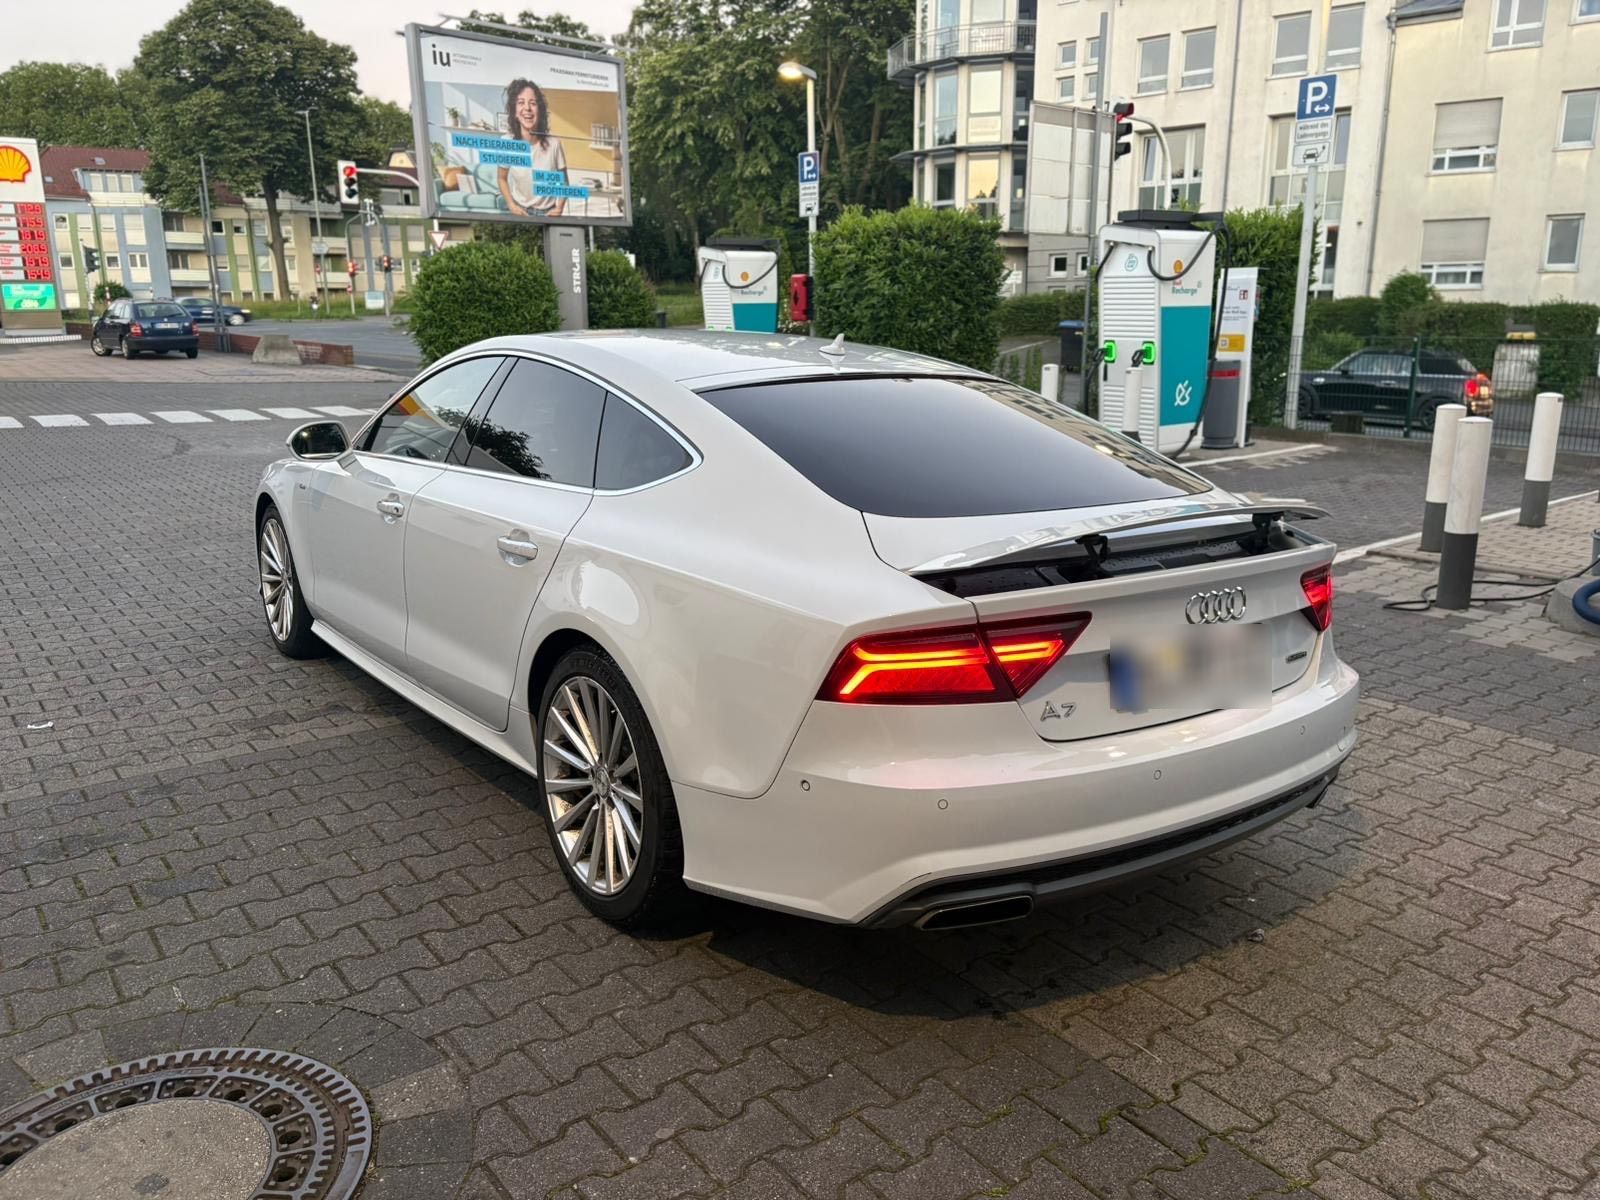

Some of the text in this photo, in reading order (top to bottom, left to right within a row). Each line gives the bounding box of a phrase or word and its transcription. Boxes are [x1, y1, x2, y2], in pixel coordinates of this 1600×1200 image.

[432, 43, 451, 67] iu
[1305, 81, 1329, 114] P
[455, 136, 527, 152] NACH FEIERABEND
[482, 153, 528, 166] STUDIEREN.
[803, 156, 815, 180] P
[535, 172, 561, 182] IM JOB
[536, 186, 585, 197] PROFITIEREN.
[1040, 700, 1077, 721] A7
